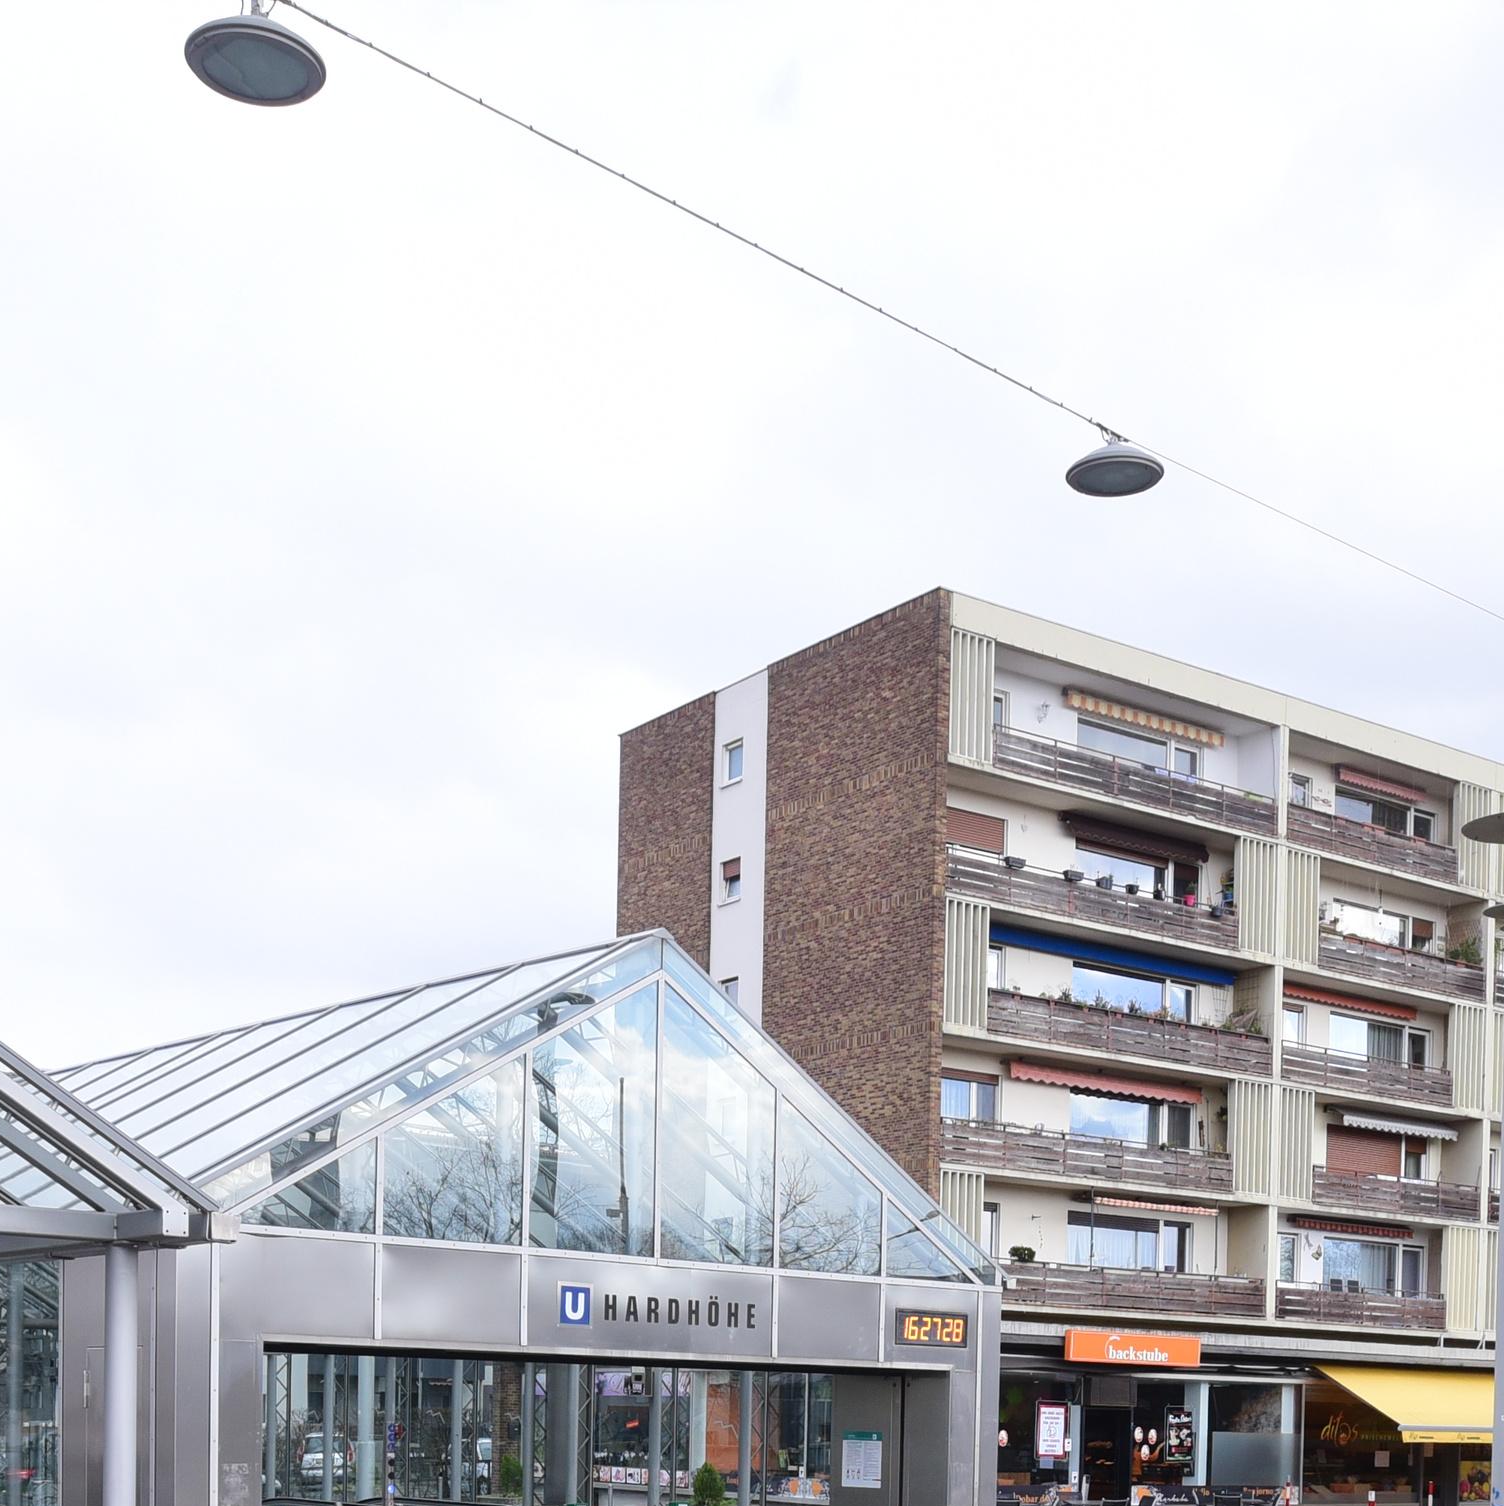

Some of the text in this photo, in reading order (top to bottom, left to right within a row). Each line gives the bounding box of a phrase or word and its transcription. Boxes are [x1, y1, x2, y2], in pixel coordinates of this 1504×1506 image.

[565, 1291, 756, 1329] U HARDHÖHE
[1108, 1345, 1169, 1362] backstube
